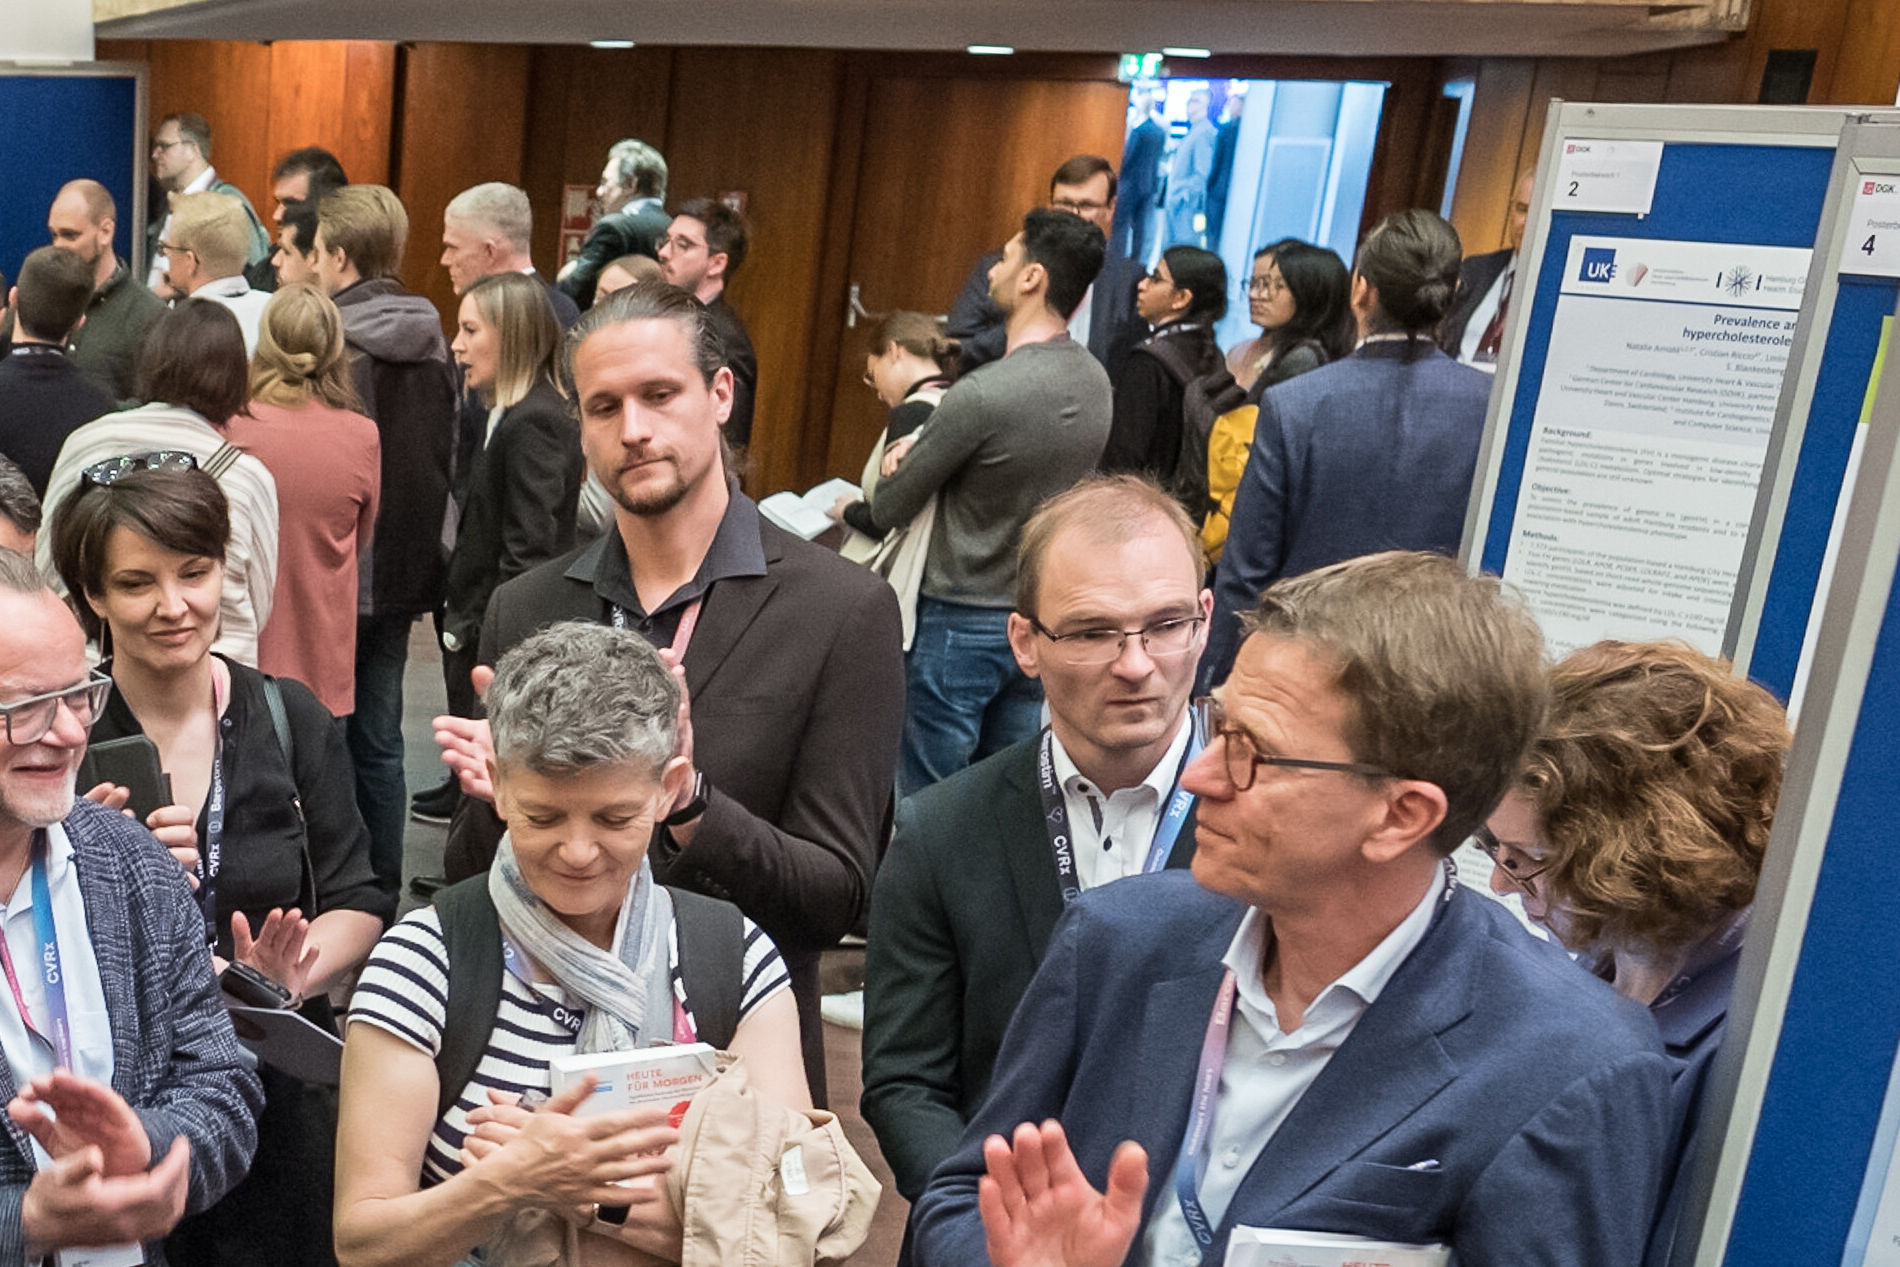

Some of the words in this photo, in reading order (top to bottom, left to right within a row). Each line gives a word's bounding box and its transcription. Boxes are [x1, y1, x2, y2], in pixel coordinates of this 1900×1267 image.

[1568, 181, 1579, 196] 2
[1861, 234, 1875, 255] 4
[1714, 314, 1780, 330] Prevalence
[209, 843, 221, 879] CVRx
[1054, 835, 1072, 875] CVRx
[44, 941, 60, 984] CVRx
[627, 1069, 662, 1080] HEUTE
[628, 1081, 649, 1092] FÜR
[653, 1074, 702, 1088] MORGEN
